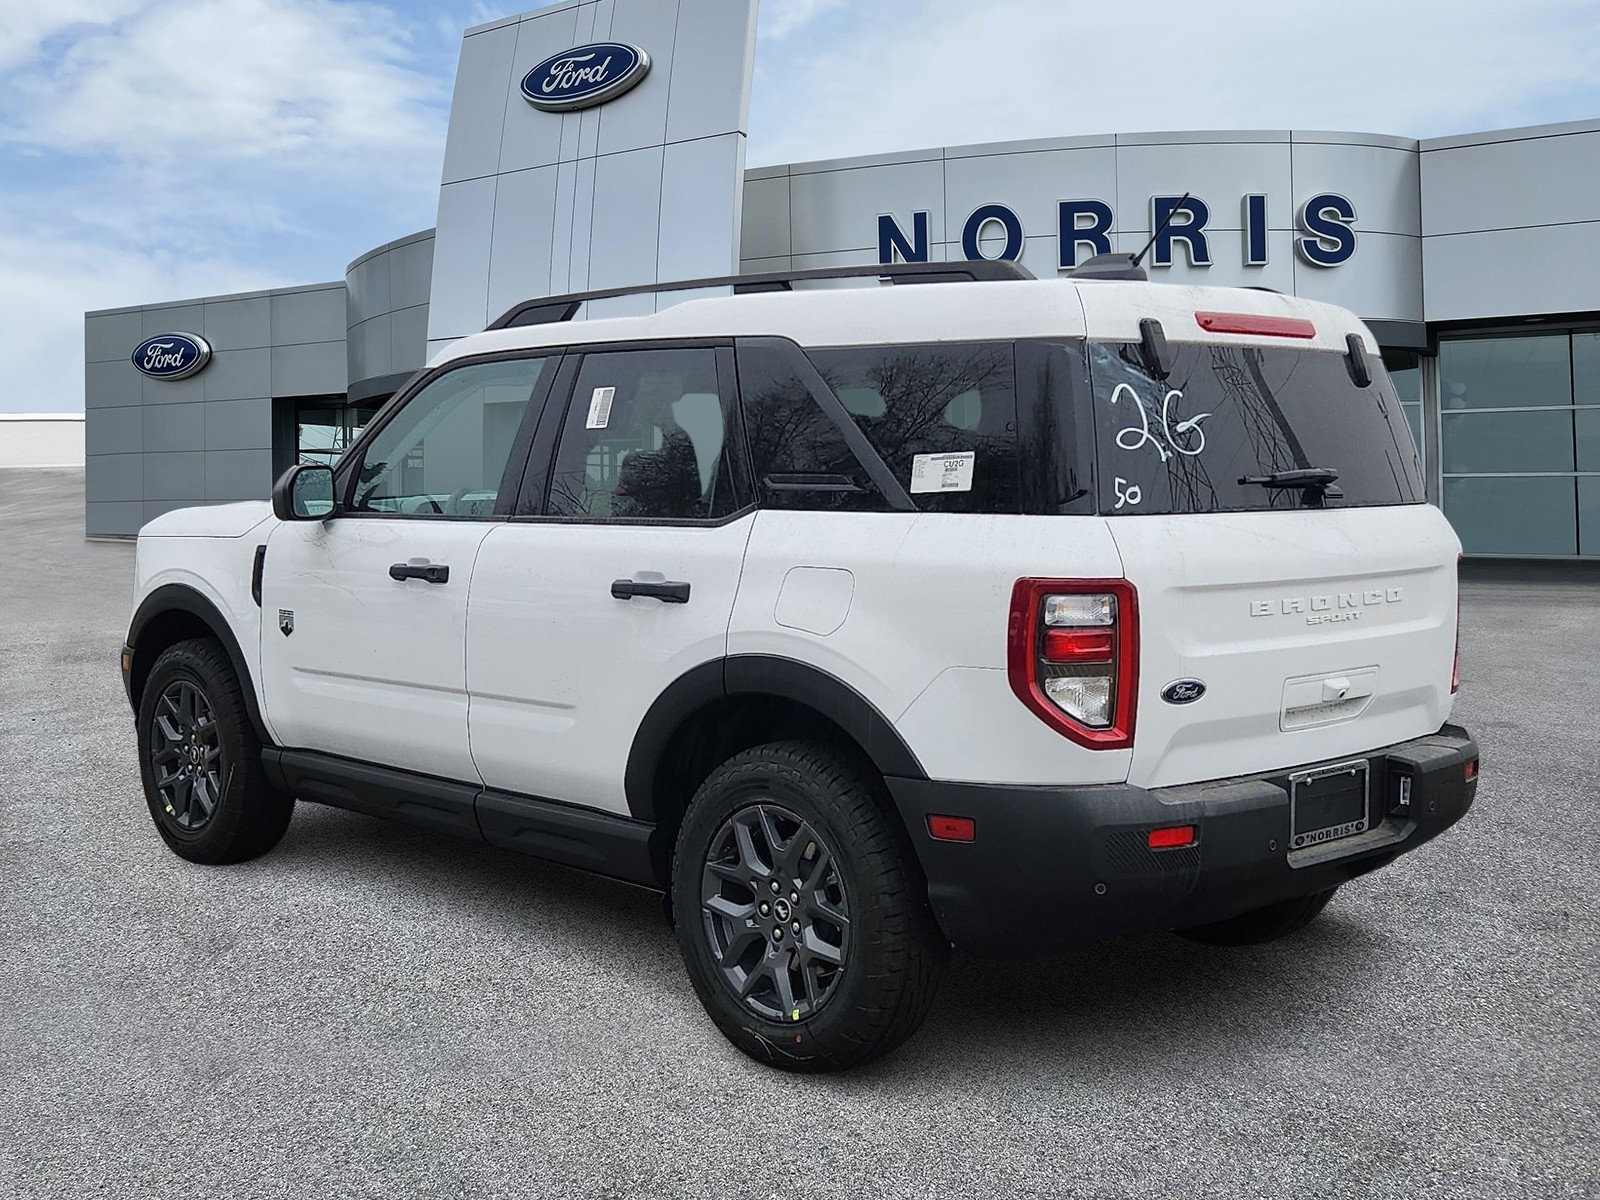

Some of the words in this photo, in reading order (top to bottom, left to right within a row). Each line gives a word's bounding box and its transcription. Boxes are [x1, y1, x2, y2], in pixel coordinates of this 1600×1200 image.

[542, 53, 612, 93] Ford
[876, 192, 1358, 280] NORRIS
[143, 342, 185, 370] Ford
[943, 459, 965, 468] CU2G
[1114, 476, 1142, 509] 50
[1250, 587, 1402, 617] BRONCO
[1305, 611, 1363, 625] SPORT
[1172, 684, 1199, 699] Ford
